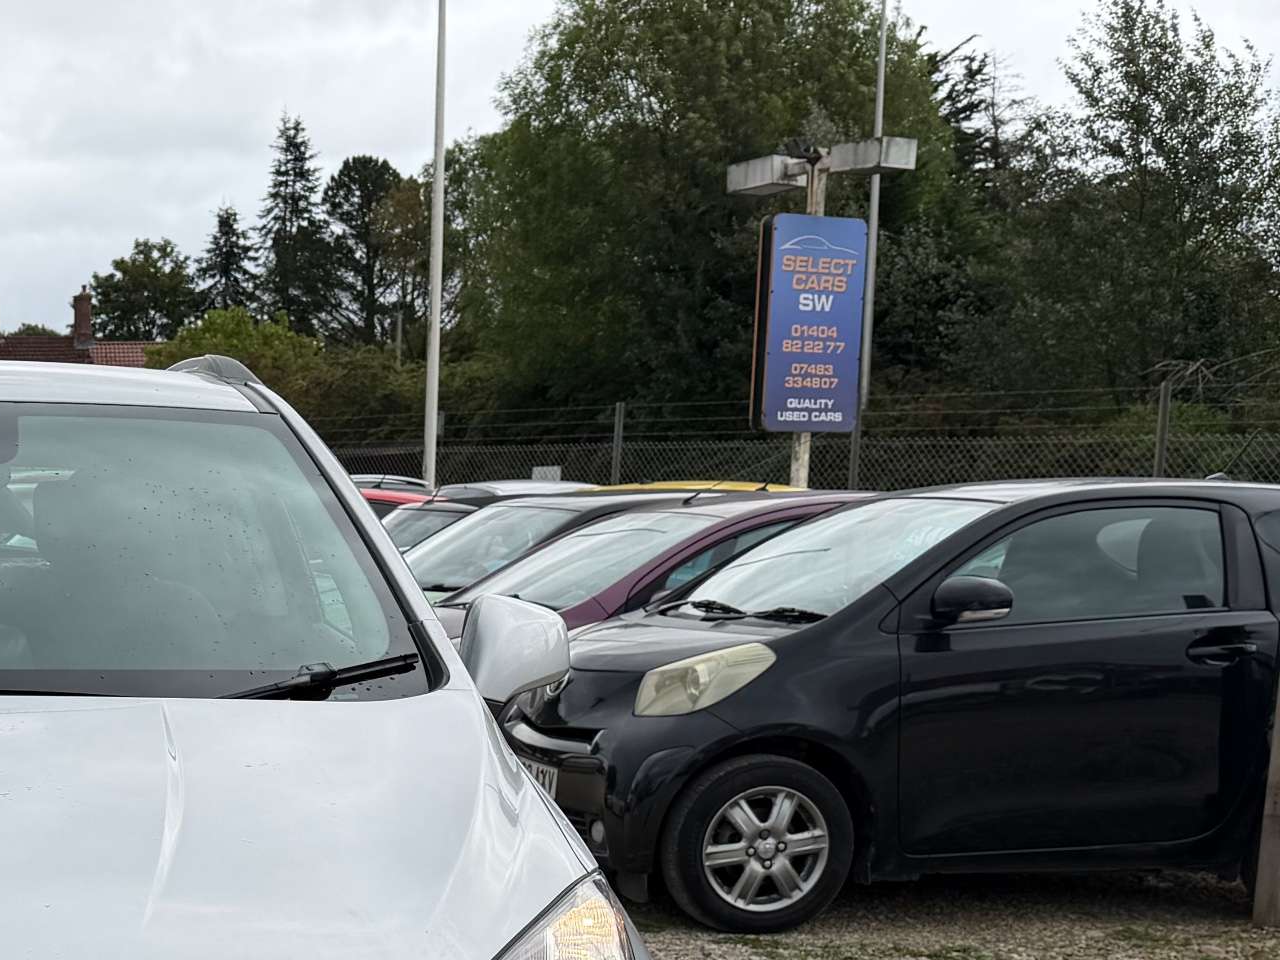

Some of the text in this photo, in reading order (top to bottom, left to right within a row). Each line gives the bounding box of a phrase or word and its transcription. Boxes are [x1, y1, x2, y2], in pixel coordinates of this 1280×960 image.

[782, 255, 856, 274] SELECT
[792, 274, 847, 292] CARS
[798, 293, 833, 312] SW
[791, 324, 837, 338] 01404
[791, 363, 833, 376] 07483
[787, 398, 834, 409] QUALITY
[777, 411, 842, 422] USED CARS
